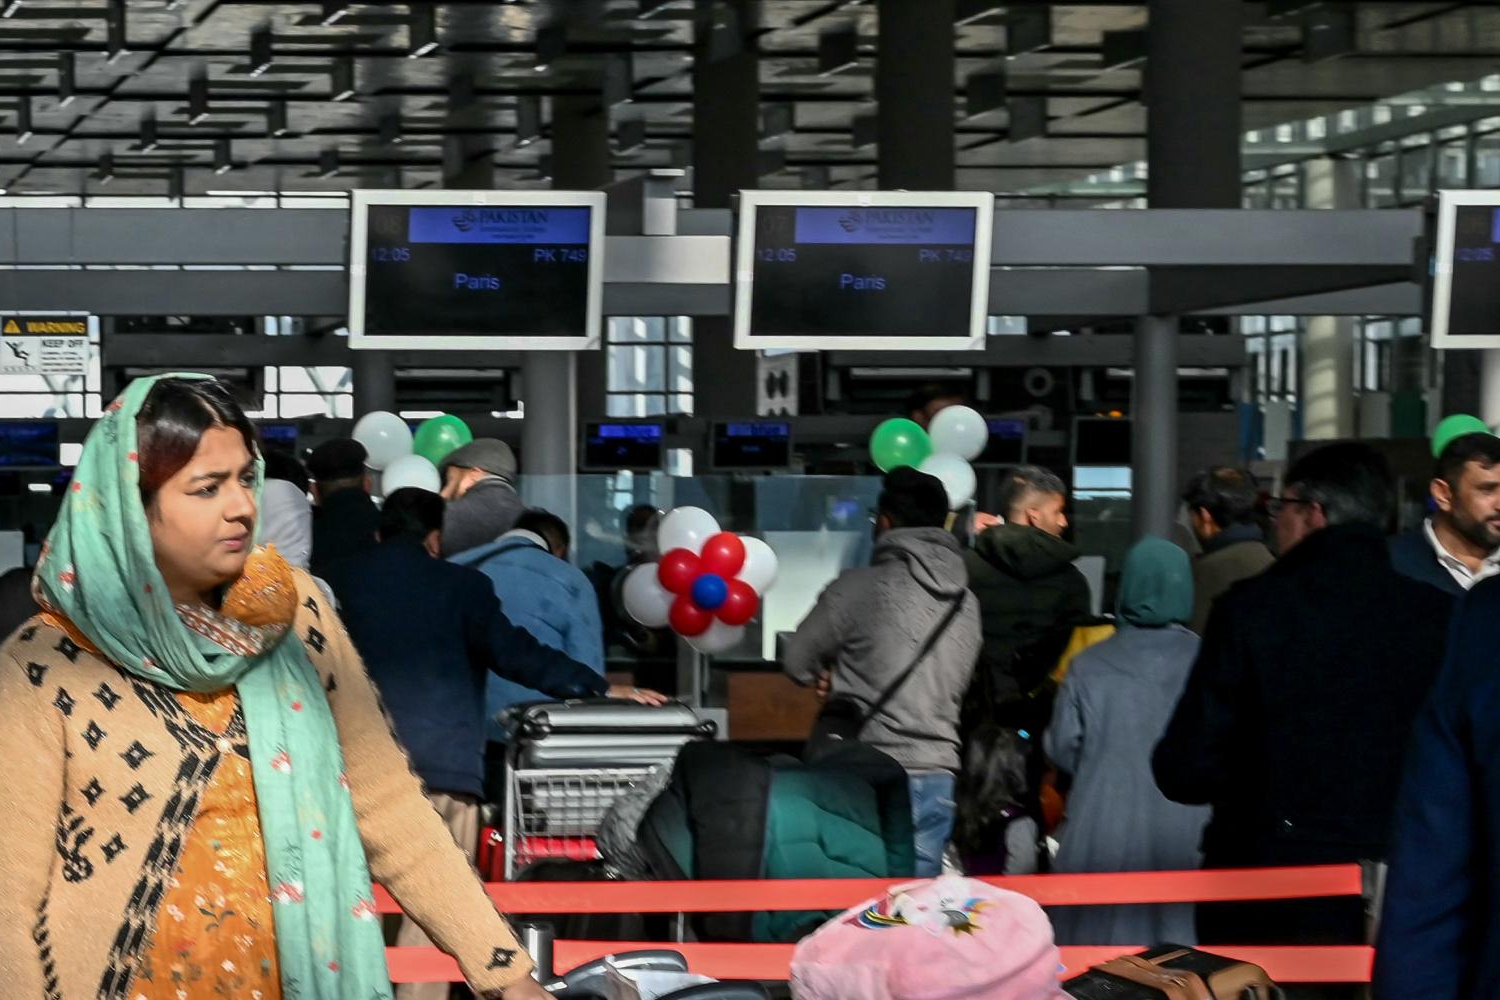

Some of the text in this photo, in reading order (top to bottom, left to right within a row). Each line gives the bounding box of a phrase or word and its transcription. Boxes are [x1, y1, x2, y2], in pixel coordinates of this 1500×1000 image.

[479, 210, 548, 224] PAKISTAN
[865, 210, 934, 224] PAKISTAN
[371, 248, 411, 262] 12:05
[533, 249, 588, 262] PK 749
[918, 249, 941, 262] PK
[454, 272, 500, 290] Paris
[840, 273, 886, 290] Paris
[26, 321, 86, 334] WARNING
